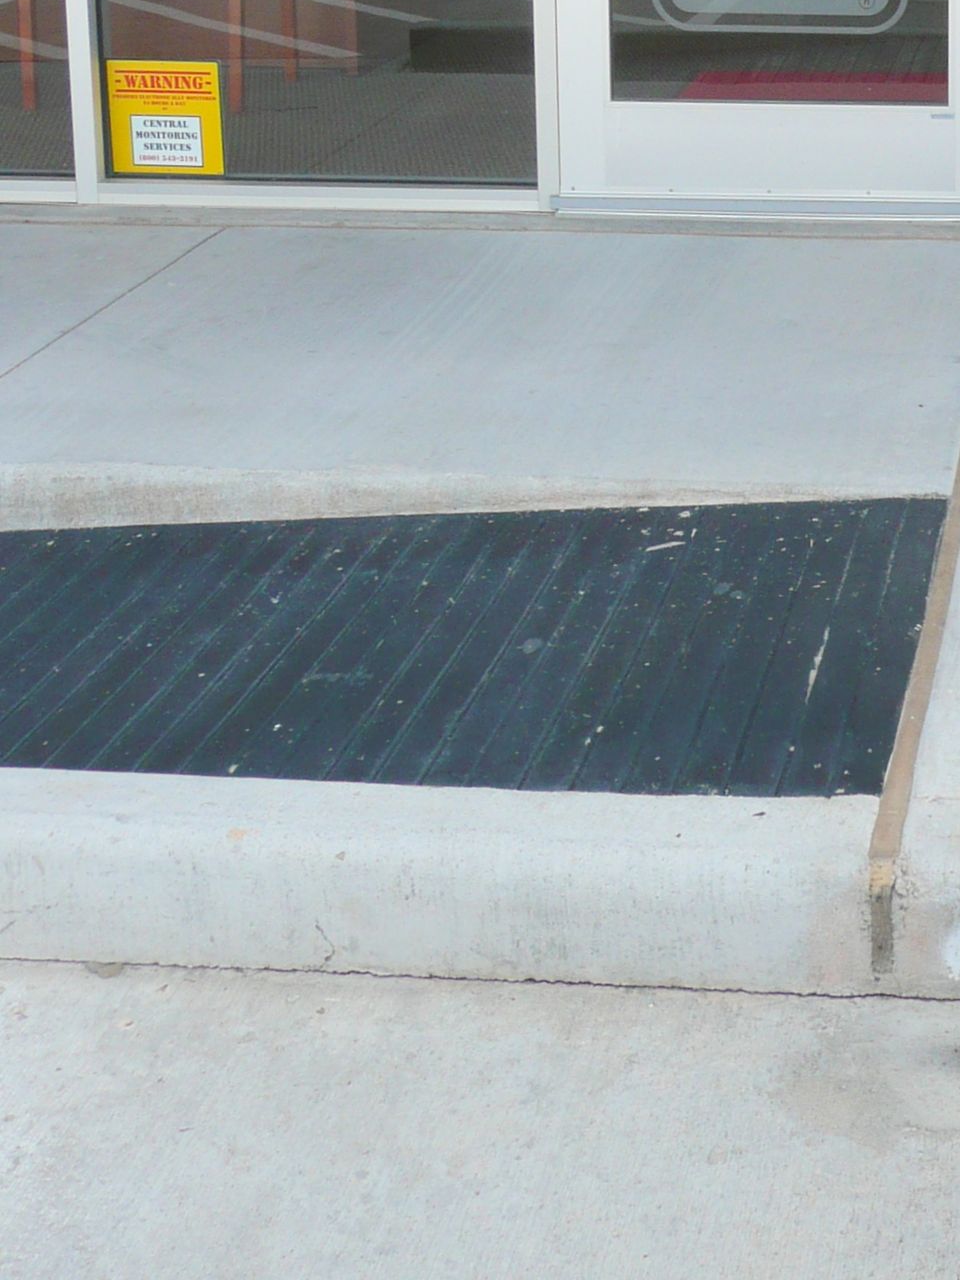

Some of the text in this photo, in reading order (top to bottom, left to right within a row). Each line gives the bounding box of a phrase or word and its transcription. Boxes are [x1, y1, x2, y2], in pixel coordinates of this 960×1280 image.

[143, 119, 188, 128] CENTRAL
[135, 130, 198, 140] MONITORING
[143, 142, 192, 152] SERVICES
